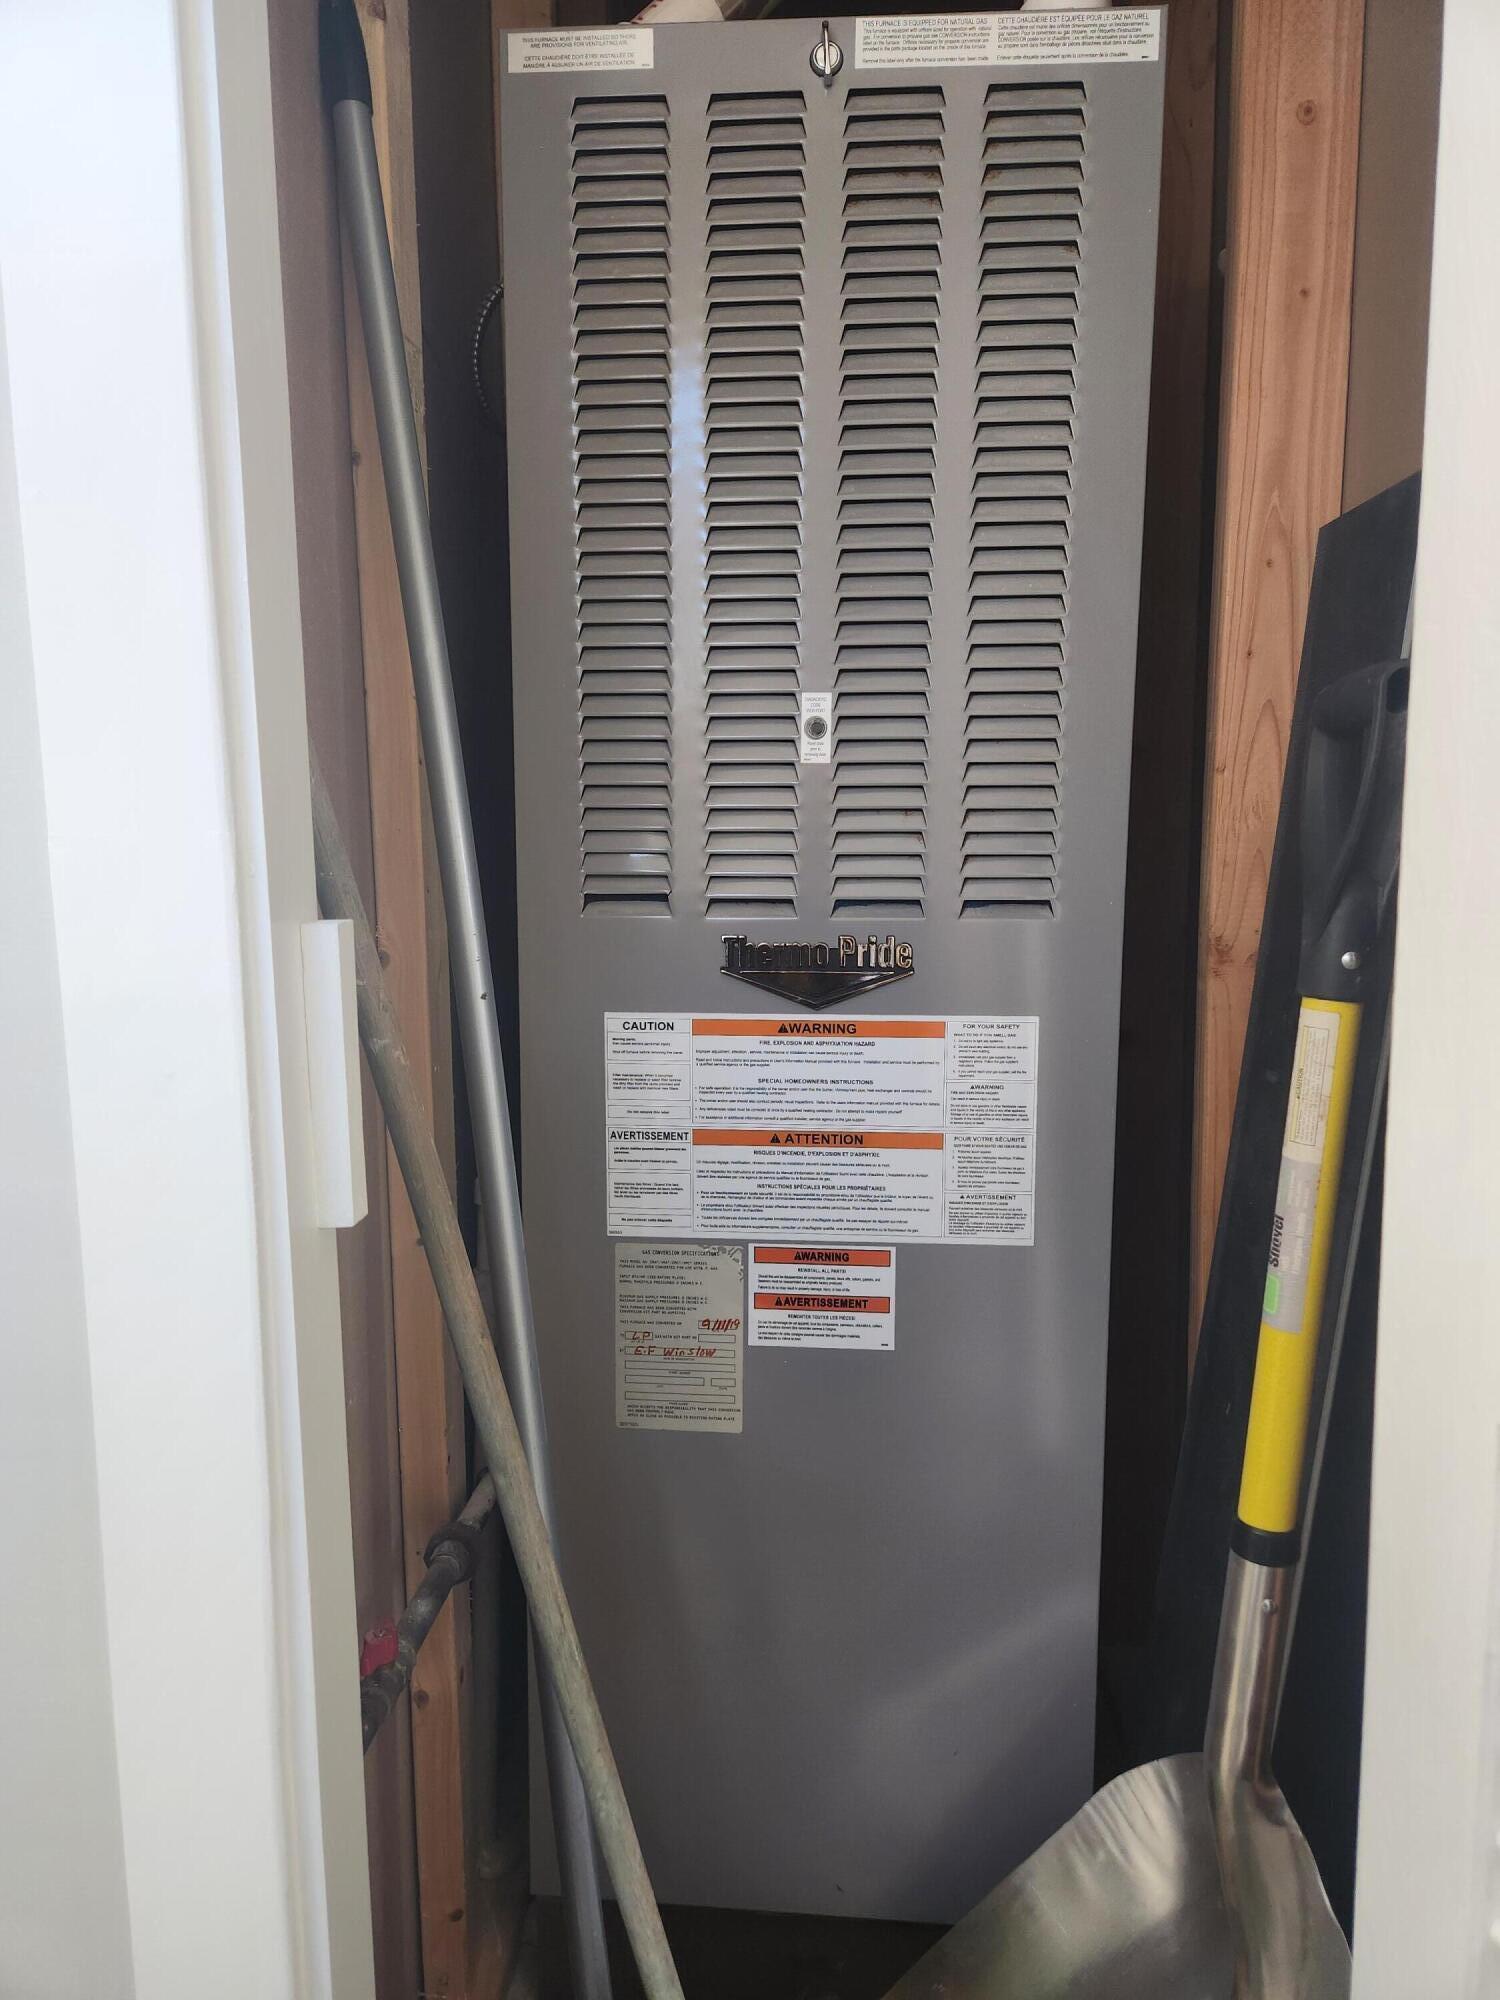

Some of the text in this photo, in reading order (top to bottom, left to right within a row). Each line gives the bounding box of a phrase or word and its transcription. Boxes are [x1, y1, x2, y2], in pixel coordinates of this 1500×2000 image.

[721, 935, 913, 969] Thermo Pride
[623, 1022, 674, 1031] CAUTION
[789, 1023, 857, 1034] WARNING
[610, 1131, 689, 1141] AVERTISSEMENT
[785, 1134, 864, 1145] ATTENTION
[801, 1252, 850, 1263] WARNING
[784, 1298, 869, 1309] AVERTISSEMENT
